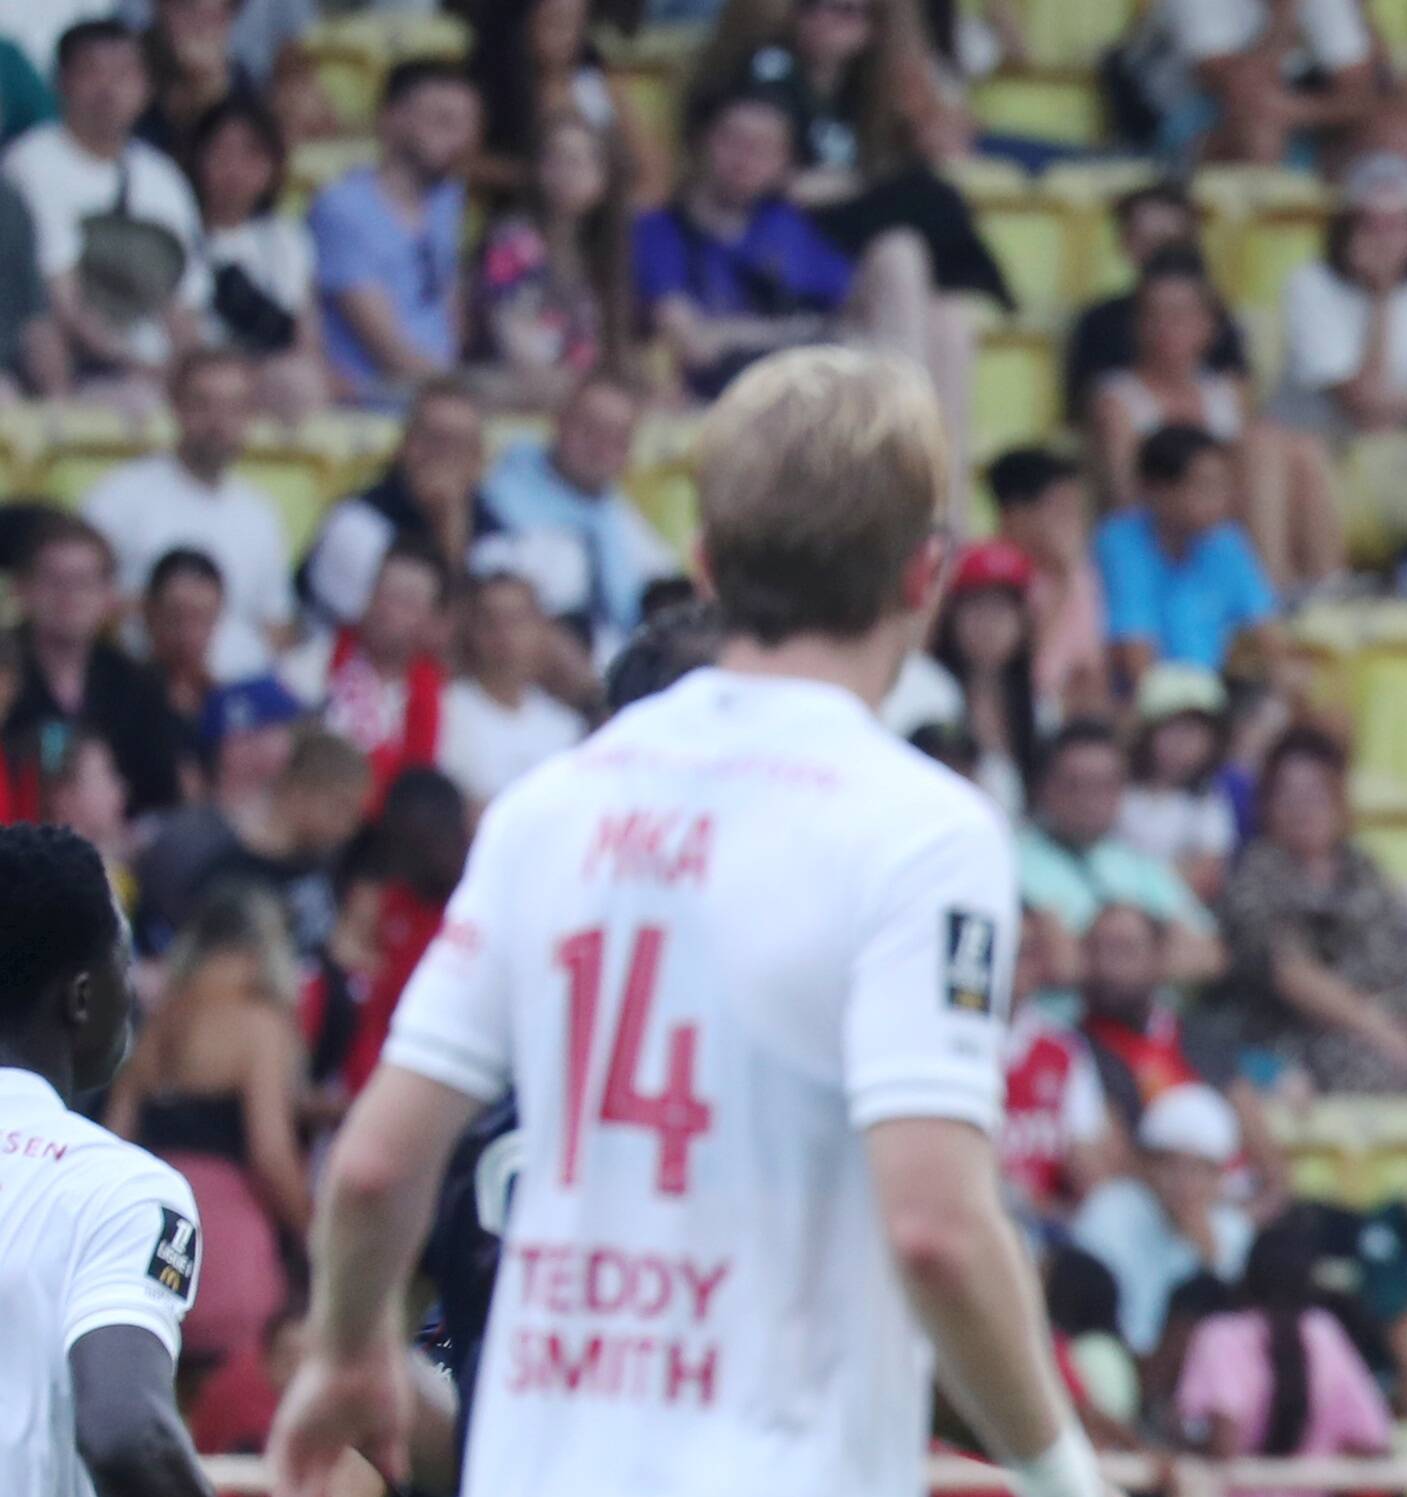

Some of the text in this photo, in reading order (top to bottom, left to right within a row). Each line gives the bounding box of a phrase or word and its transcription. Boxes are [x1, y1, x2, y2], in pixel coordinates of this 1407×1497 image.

[553, 922, 711, 1197] 14
[0, 1130, 68, 1163] SEN
[517, 1247, 729, 1324] TEDDY
[508, 1330, 718, 1403] SMITH
